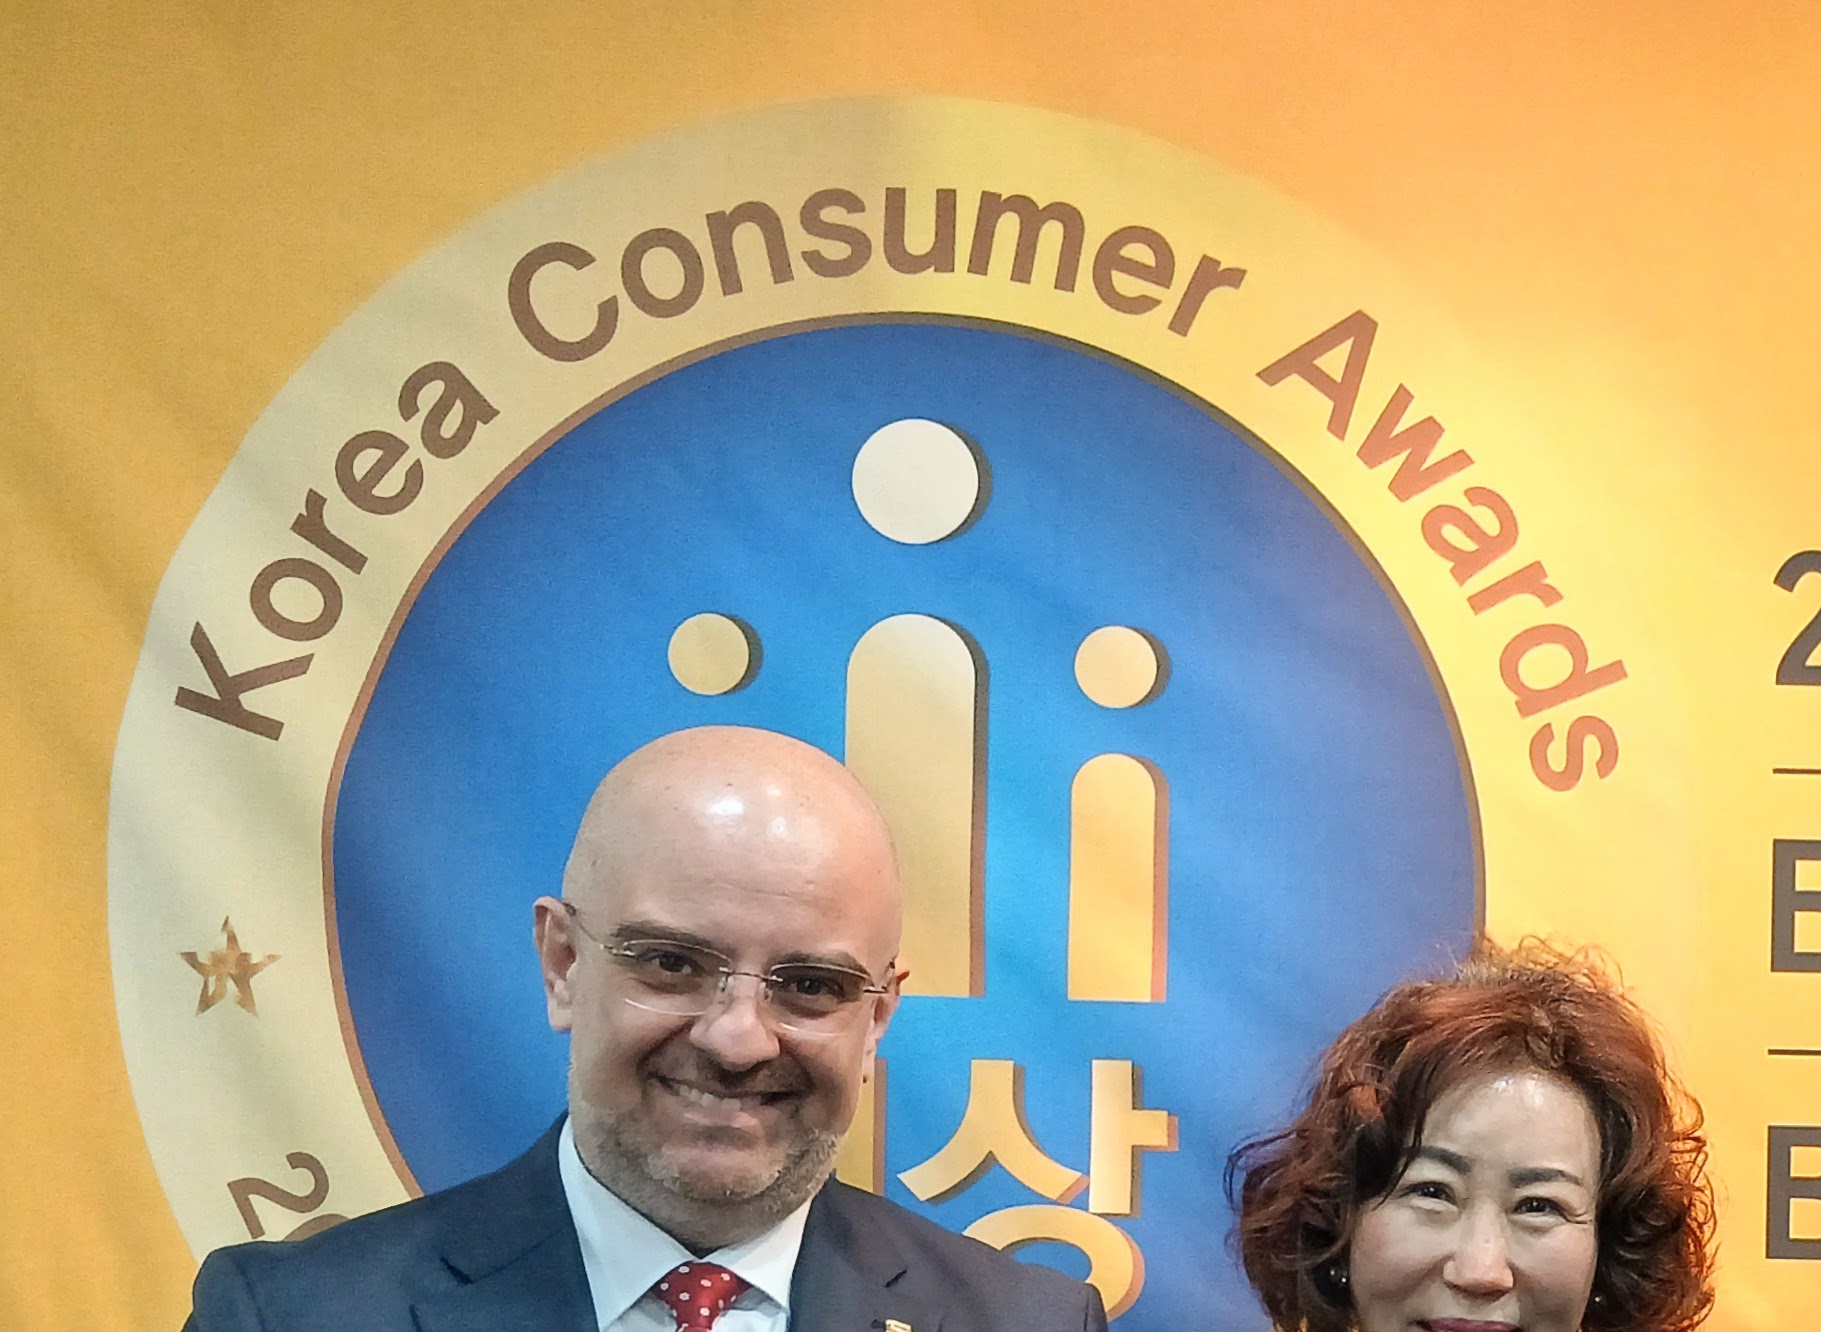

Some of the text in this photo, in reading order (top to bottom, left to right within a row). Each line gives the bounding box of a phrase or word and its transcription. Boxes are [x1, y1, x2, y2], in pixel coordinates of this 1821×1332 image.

[174, 187, 1628, 791] Korea Consumer Awards
[850, 1058, 1179, 1323] 상
